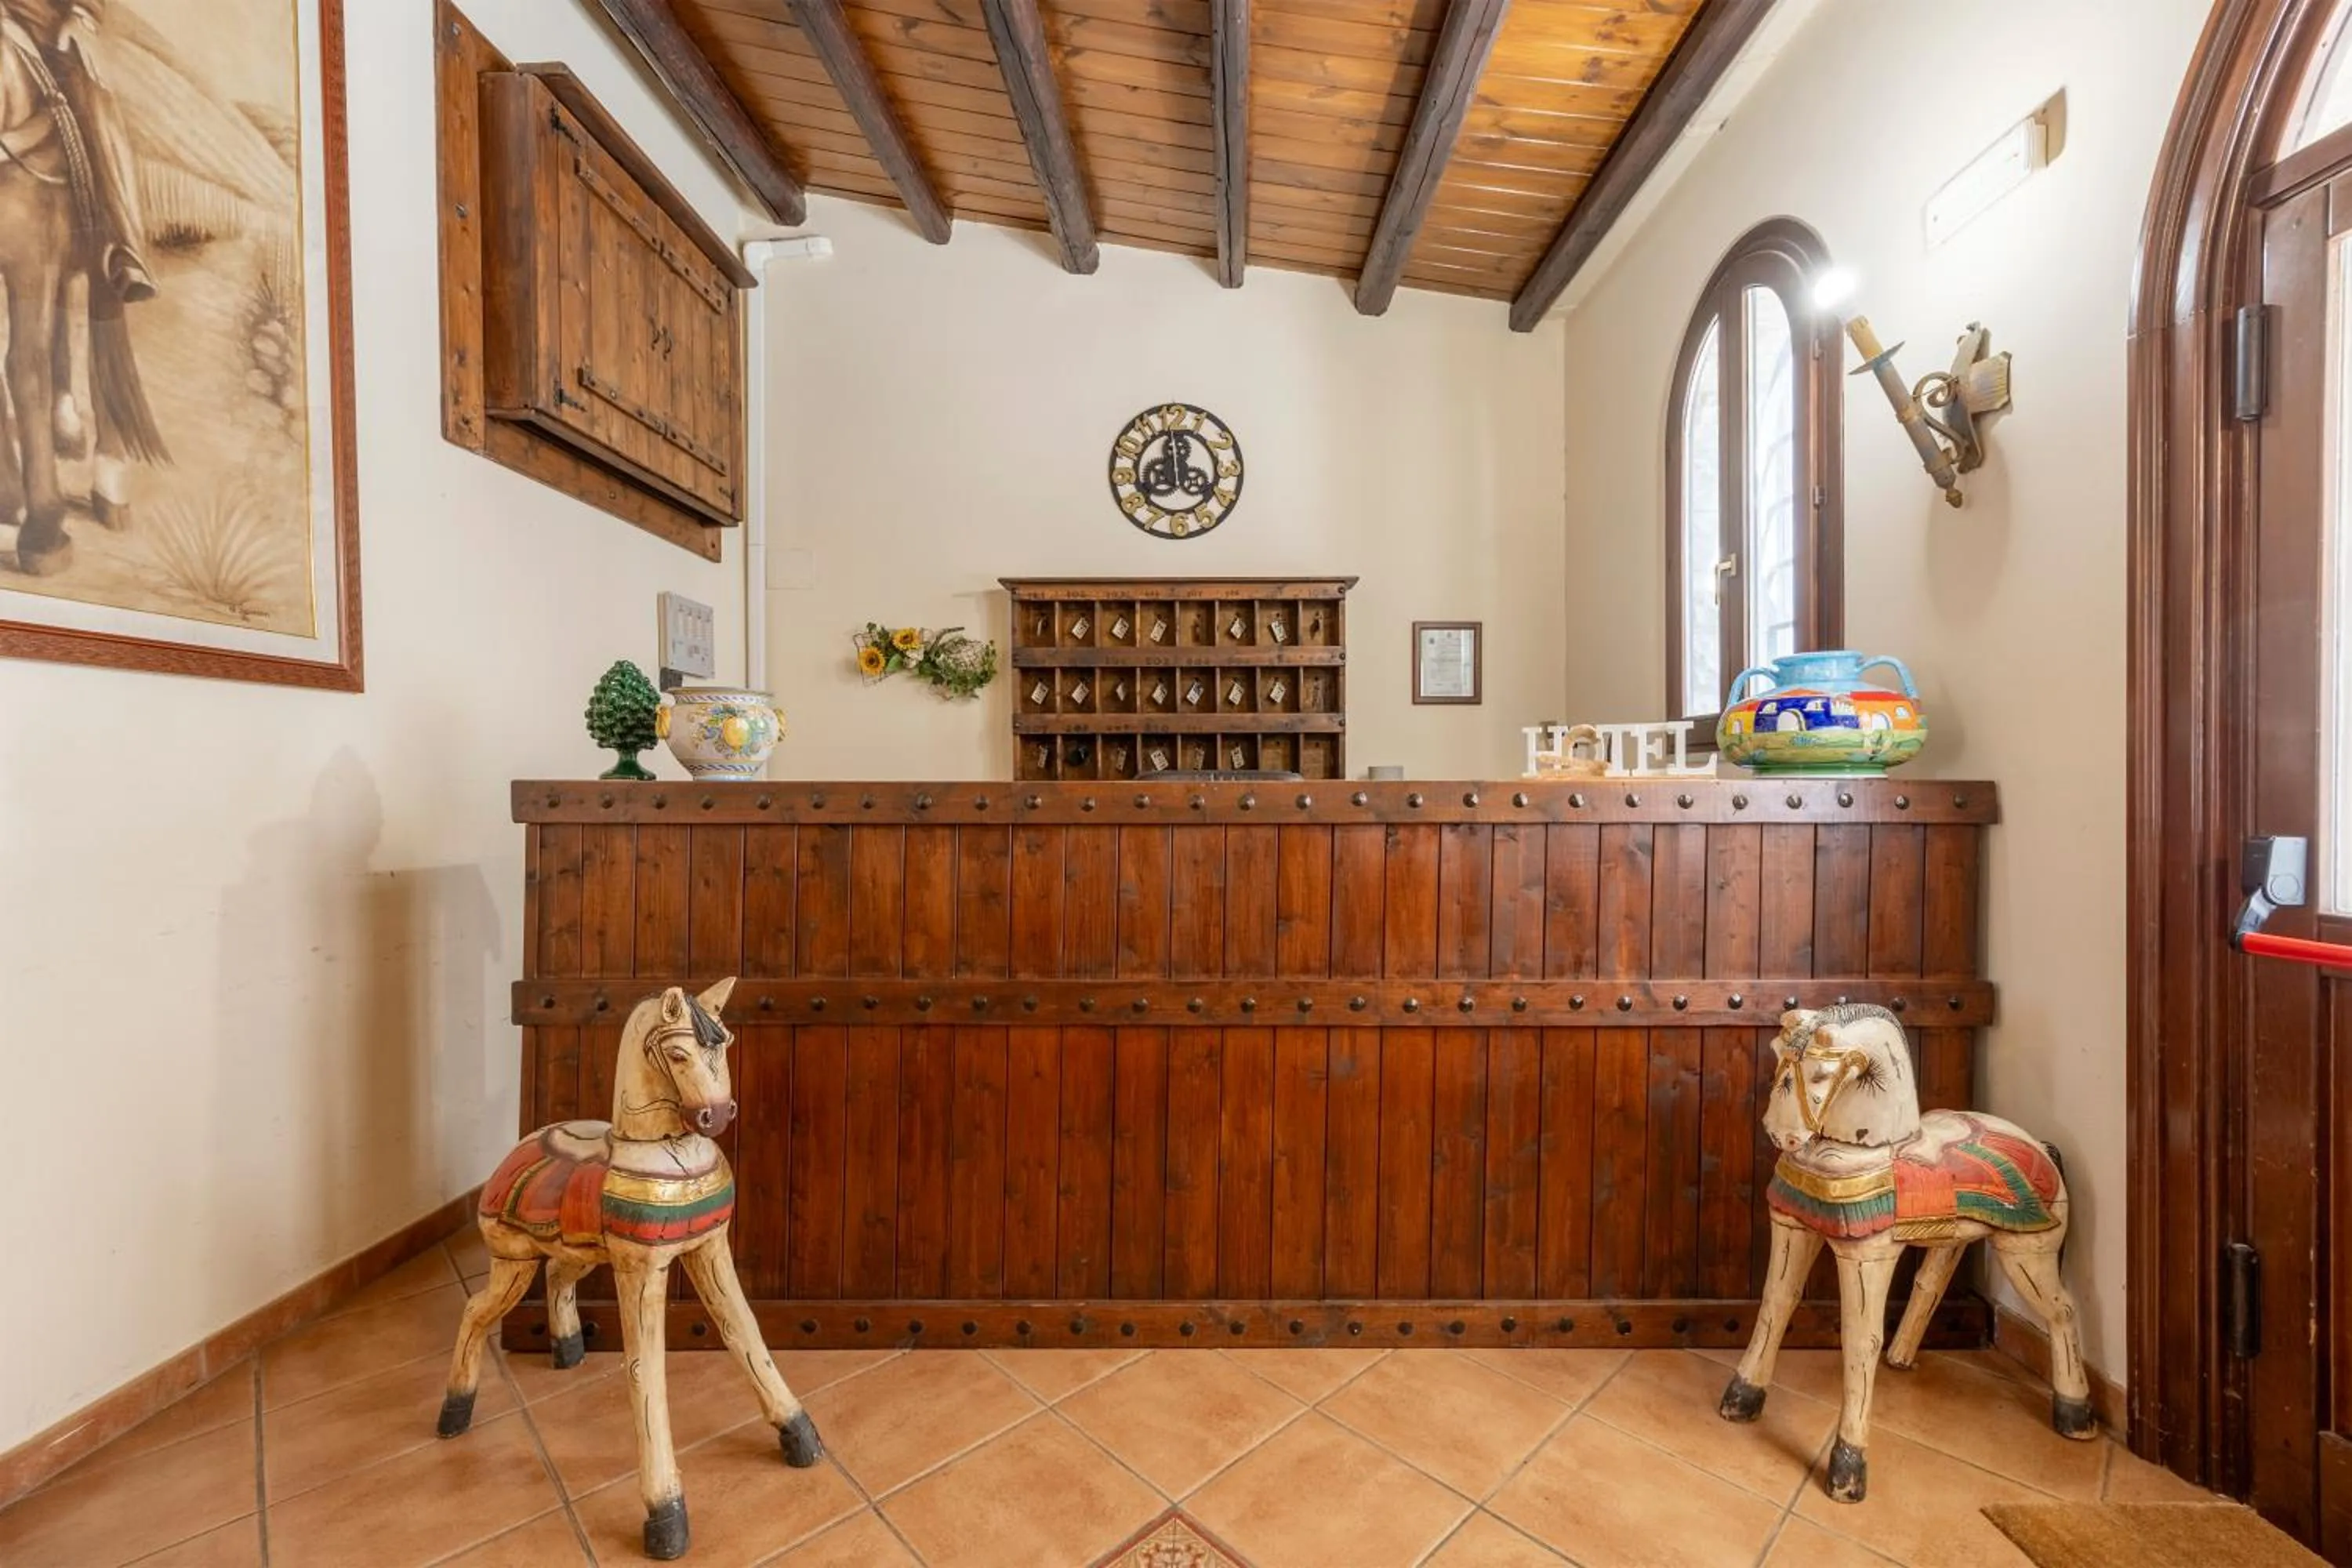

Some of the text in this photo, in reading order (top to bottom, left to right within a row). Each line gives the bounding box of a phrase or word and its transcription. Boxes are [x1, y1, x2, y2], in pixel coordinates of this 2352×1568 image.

[1134, 413, 1159, 440] 11
[1158, 405, 1187, 430] 12
[1192, 412, 1207, 435] 1
[1114, 434, 1143, 461] 10
[1207, 430, 1232, 456] 2
[1112, 467, 1137, 485] 9
[1217, 459, 1240, 478] 3
[1121, 492, 1145, 514] 8
[1213, 486, 1236, 509] 4
[1145, 506, 1165, 531] 7
[1170, 512, 1189, 537] 6
[1194, 503, 1217, 528] 5
